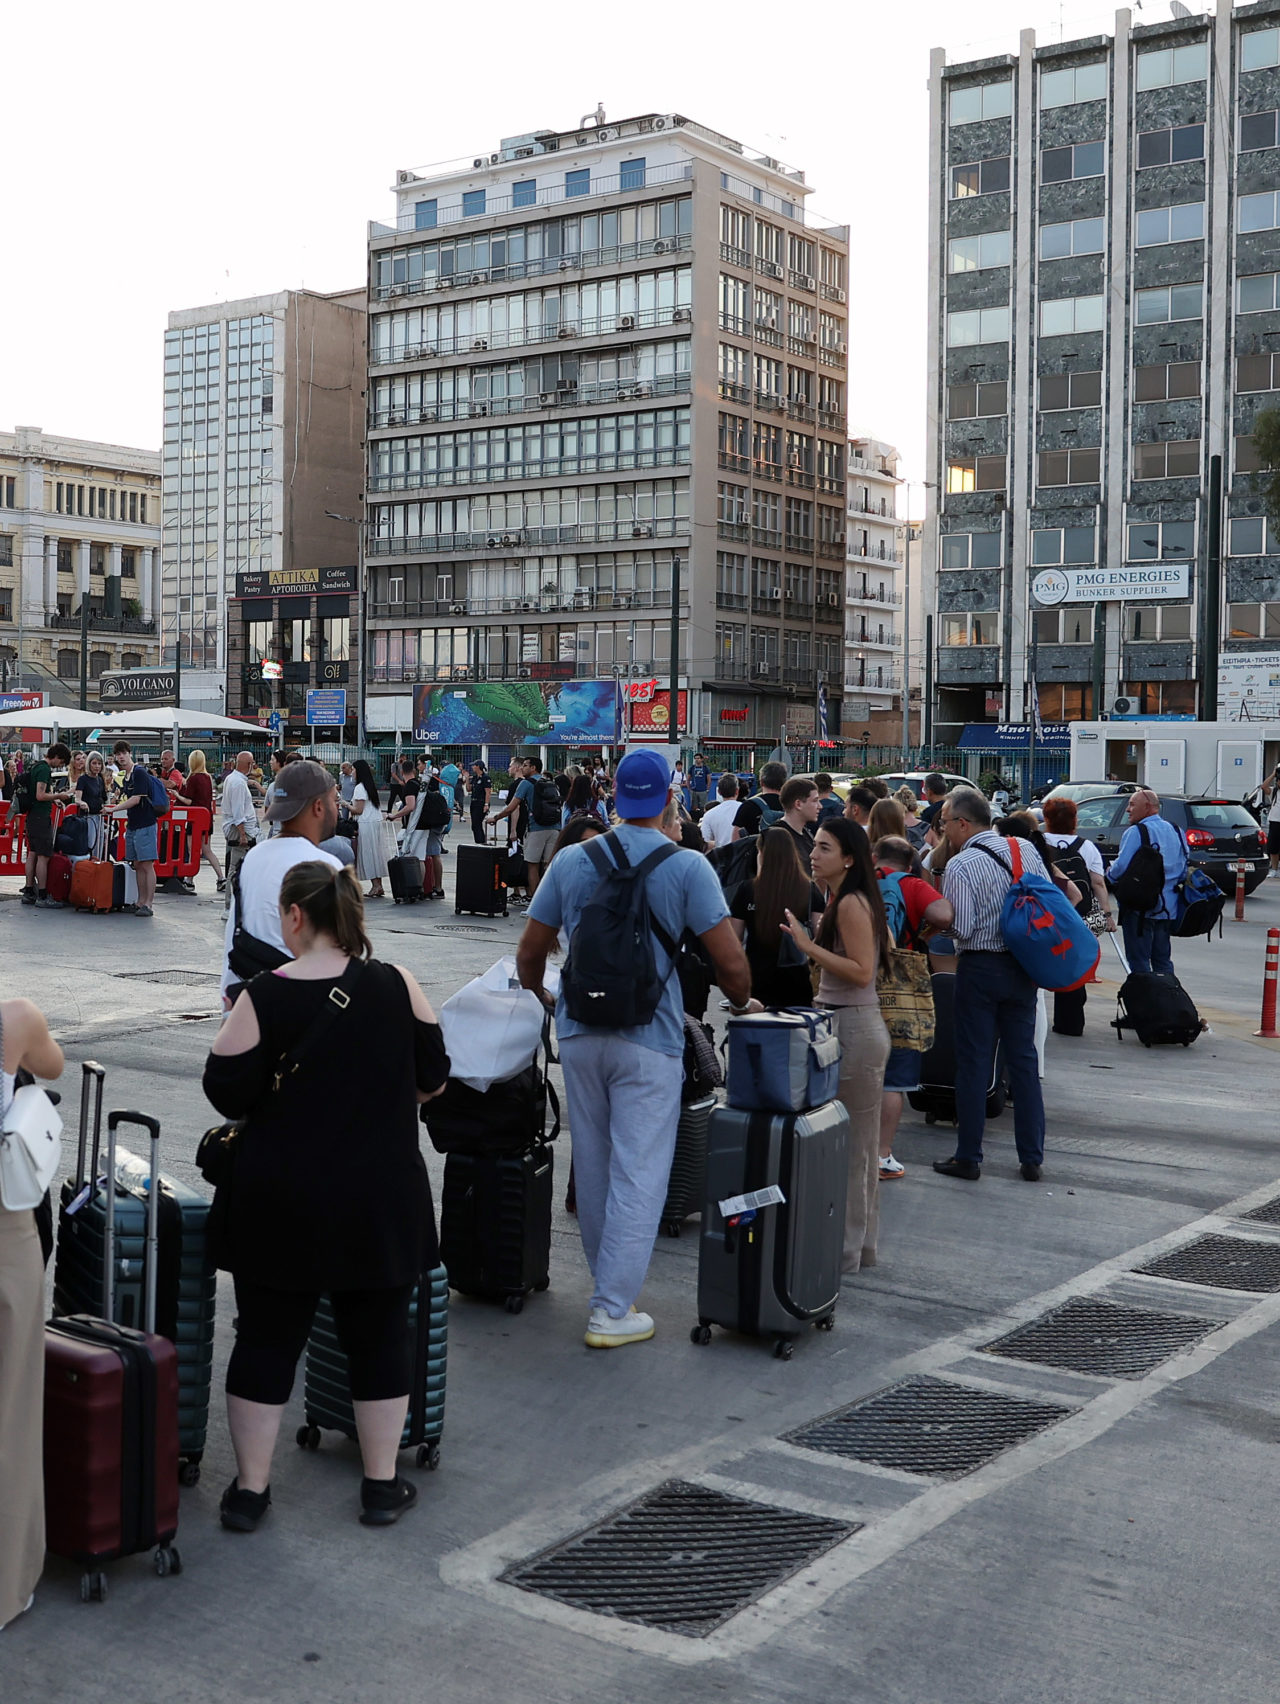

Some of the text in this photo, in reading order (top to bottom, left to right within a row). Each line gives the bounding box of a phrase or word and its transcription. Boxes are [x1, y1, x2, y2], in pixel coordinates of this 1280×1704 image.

[326, 570, 346, 578] Coffee
[1076, 570, 1180, 585] PMG ENERGIES
[243, 575, 262, 584] Bakery
[322, 580, 351, 589] Sandwich
[244, 586, 261, 594] Pastry
[271, 584, 317, 594] ΑΡΤΟΠΟΙΕΙΑ
[1035, 583, 1065, 593] PMG
[1076, 586, 1168, 597] BUNKER SUPPLIER
[121, 677, 174, 690] VOLCANO
[3, 698, 31, 708] freenow
[415, 729, 440, 741] Uber
[560, 734, 578, 742] You're
